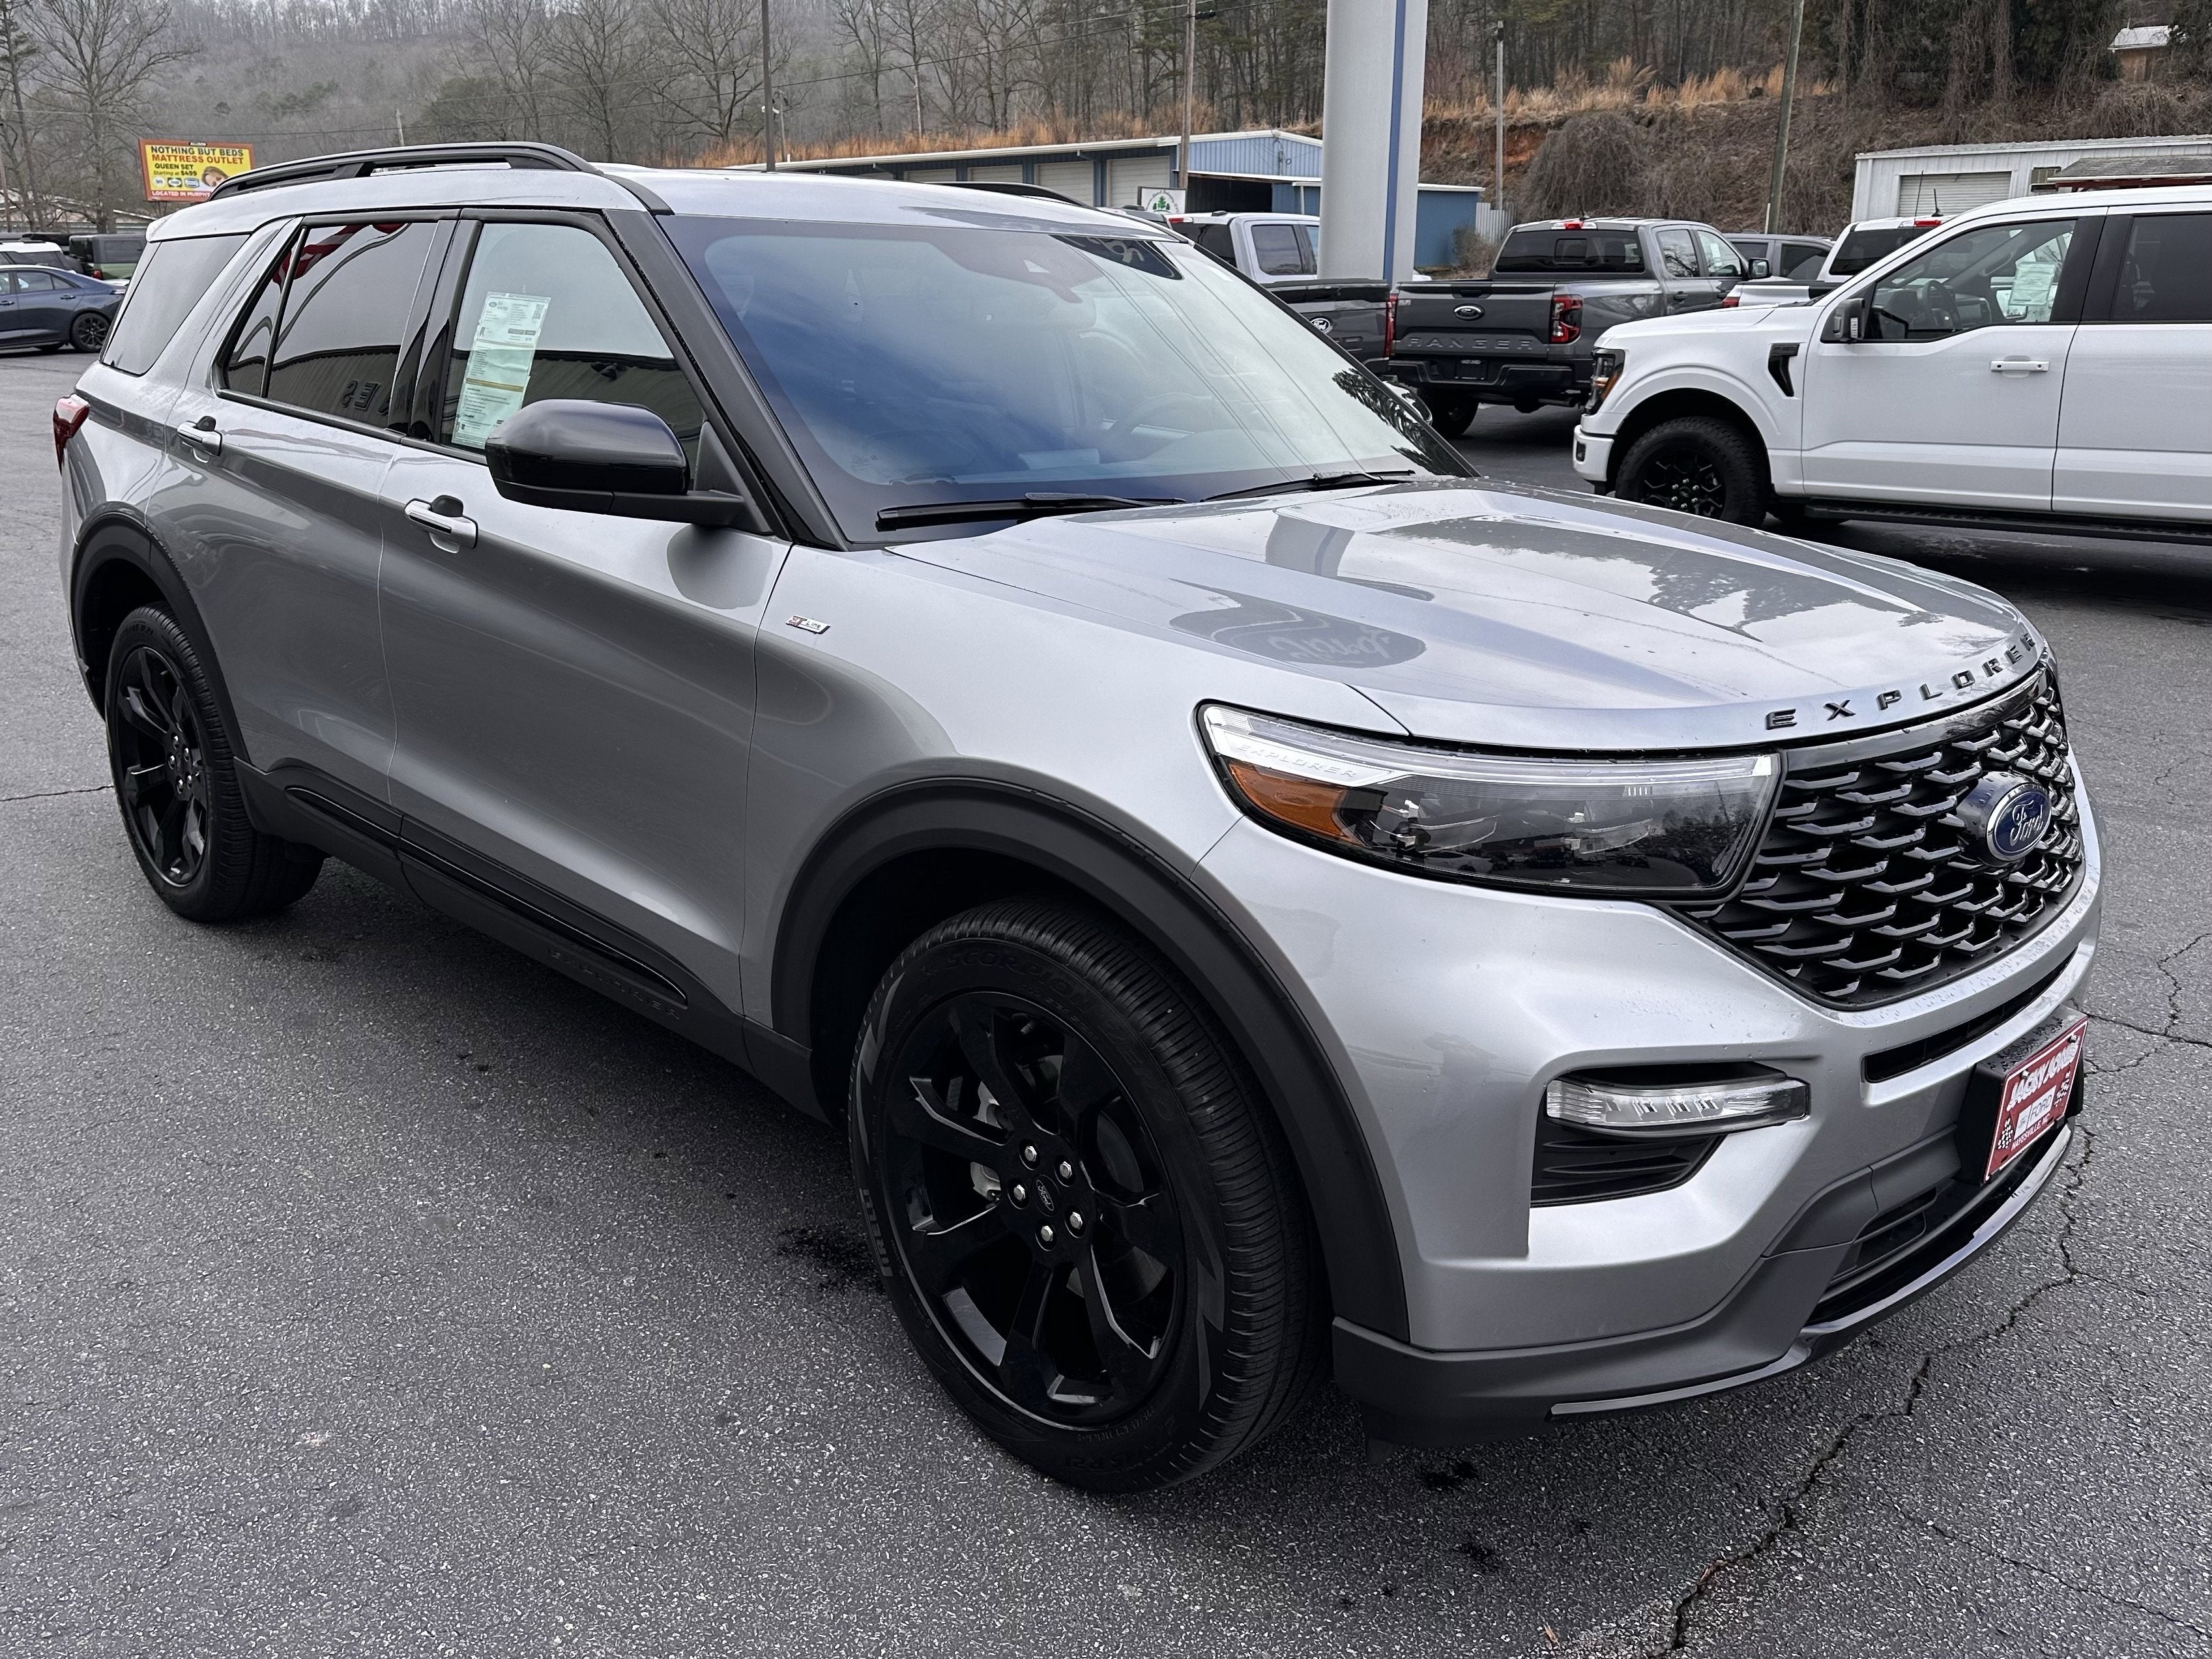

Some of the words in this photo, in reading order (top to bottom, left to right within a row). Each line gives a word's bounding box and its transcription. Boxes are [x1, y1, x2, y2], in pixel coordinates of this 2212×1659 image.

[151, 146, 195, 154] NOTHING
[152, 154, 204, 163] MATTRESS
[788, 615, 808, 626] ST
[1766, 633, 2036, 730] EXPLORER
[1238, 745, 1357, 777] EXPLORER
[2009, 799, 2044, 846] Ford
[2006, 1059, 2051, 1112] JACKY
[2030, 1093, 2052, 1122] FORD
[861, 1188, 894, 1277] PIRELLI
